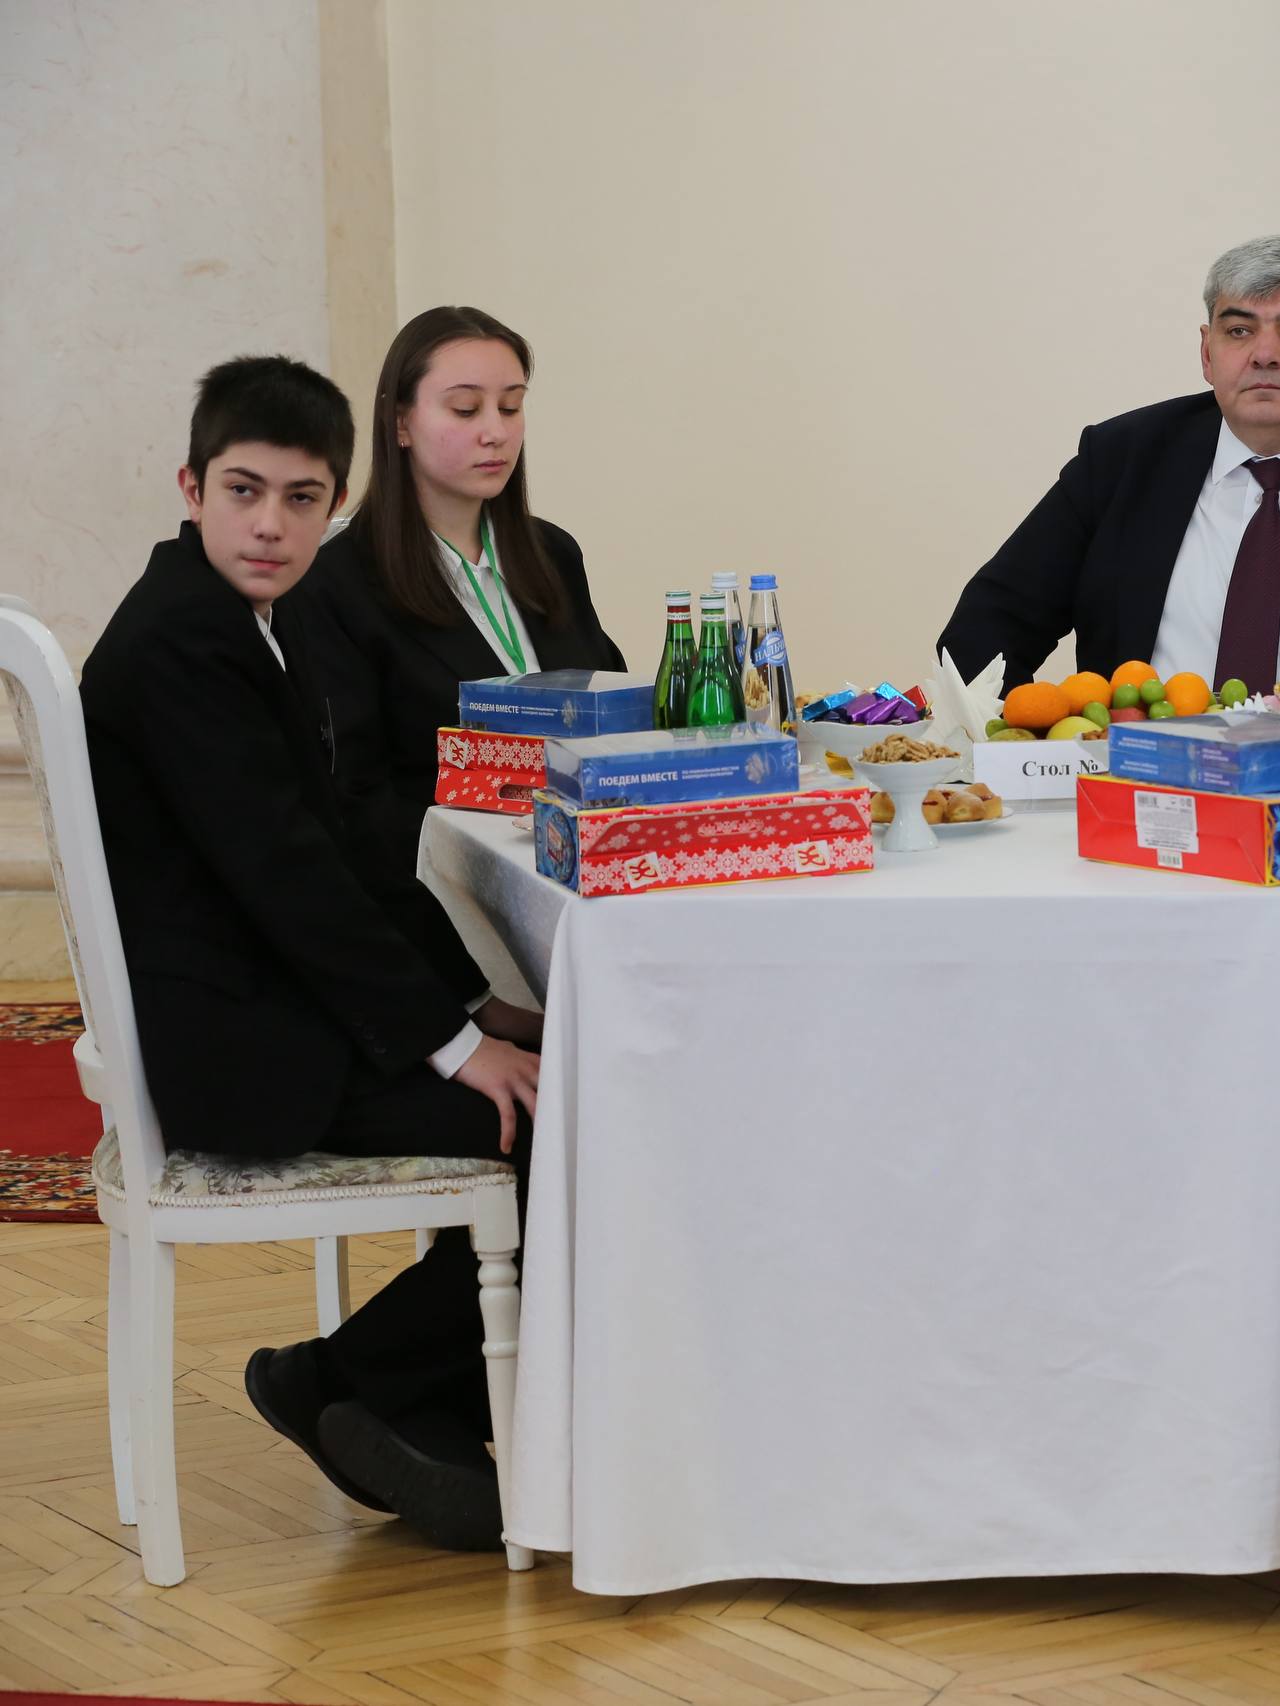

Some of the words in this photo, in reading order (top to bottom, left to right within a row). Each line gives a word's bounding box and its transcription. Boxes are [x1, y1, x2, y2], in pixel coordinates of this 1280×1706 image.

[469, 702, 495, 713] ПОЕДЕМ
[496, 705, 519, 714] ВМЕСТЕ
[1022, 760, 1070, 776] Стол
[1076, 759, 1098, 775] №
[598, 774, 640, 787] ПОЕДЕМ
[641, 770, 678, 783] ВМЕСТЕ
